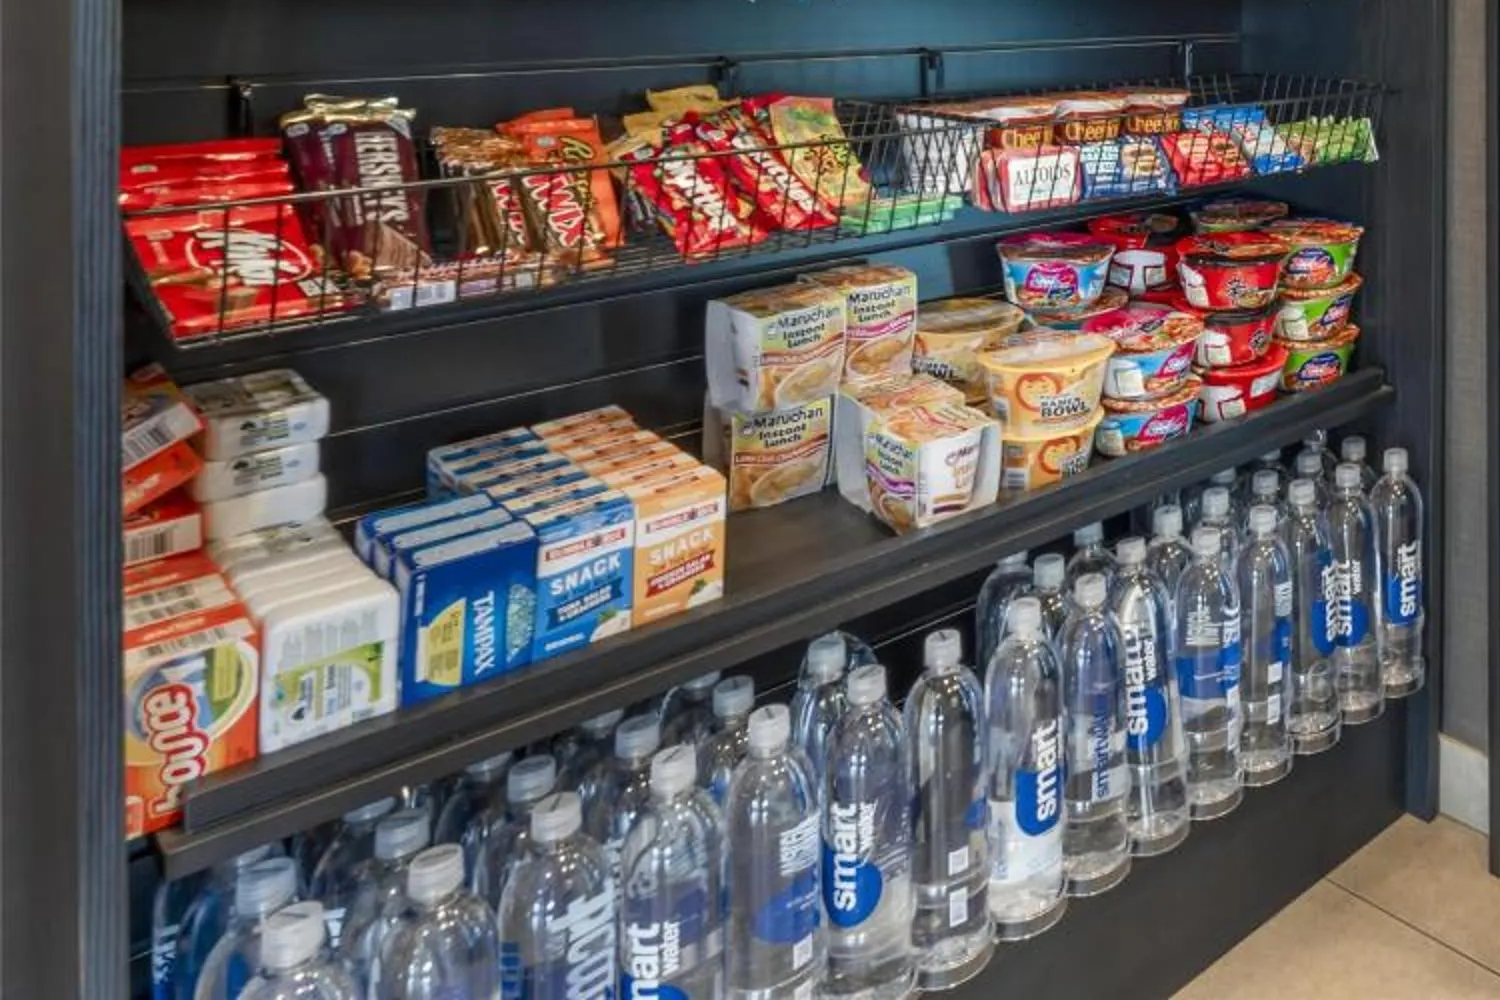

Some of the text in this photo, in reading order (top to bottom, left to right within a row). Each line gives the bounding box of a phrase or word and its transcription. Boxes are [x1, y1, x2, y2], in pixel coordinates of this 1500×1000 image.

[848, 284, 912, 306] Maruchan
[852, 298, 898, 315] Instant
[777, 306, 841, 330] Maruchan
[782, 322, 827, 341] Instant
[752, 405, 824, 430] Maruchan
[757, 422, 808, 441] Instant
[763, 432, 803, 449] Lunch
[650, 527, 715, 567] SNACK
[550, 551, 622, 596] SNACK
[1396, 539, 1417, 617] smart
[1333, 559, 1353, 637] smart
[473, 590, 496, 676] TAMPAX
[1033, 719, 1058, 822] smart
[830, 802, 858, 912] smart
[627, 922, 661, 1000] mart
[660, 919, 682, 976] water
